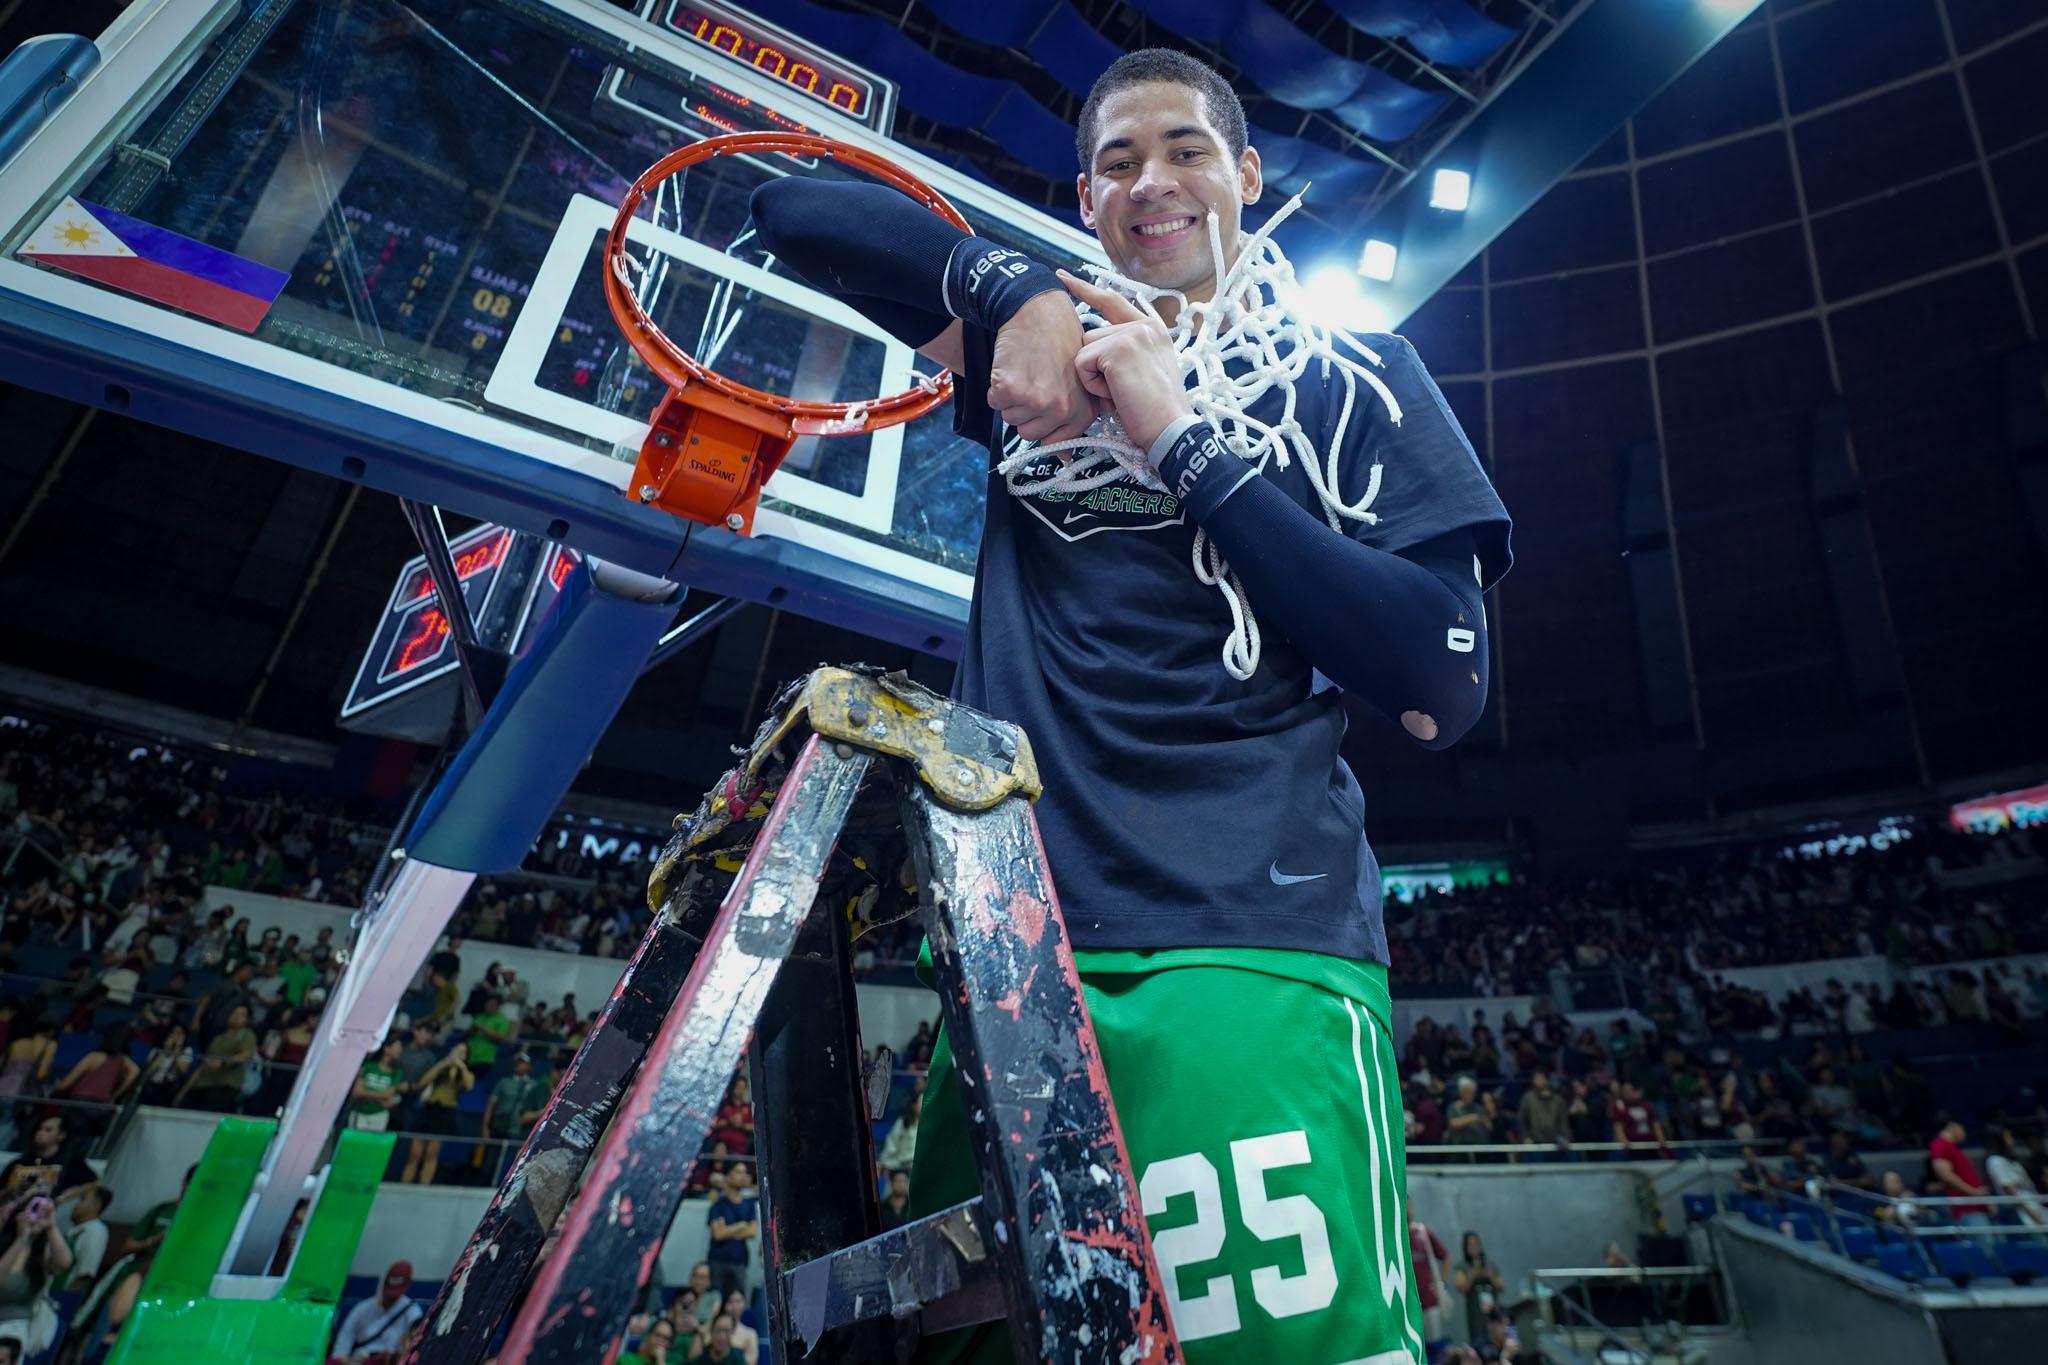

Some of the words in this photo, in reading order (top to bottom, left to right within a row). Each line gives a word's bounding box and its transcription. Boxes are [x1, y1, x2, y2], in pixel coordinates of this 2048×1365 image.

[969, 249, 1027, 293] Jesu
[998, 262, 1029, 279] Is
[689, 458, 736, 483] SPALDING
[1078, 487, 1179, 516] ARCHERS
[1139, 1130, 1340, 1343] 25
